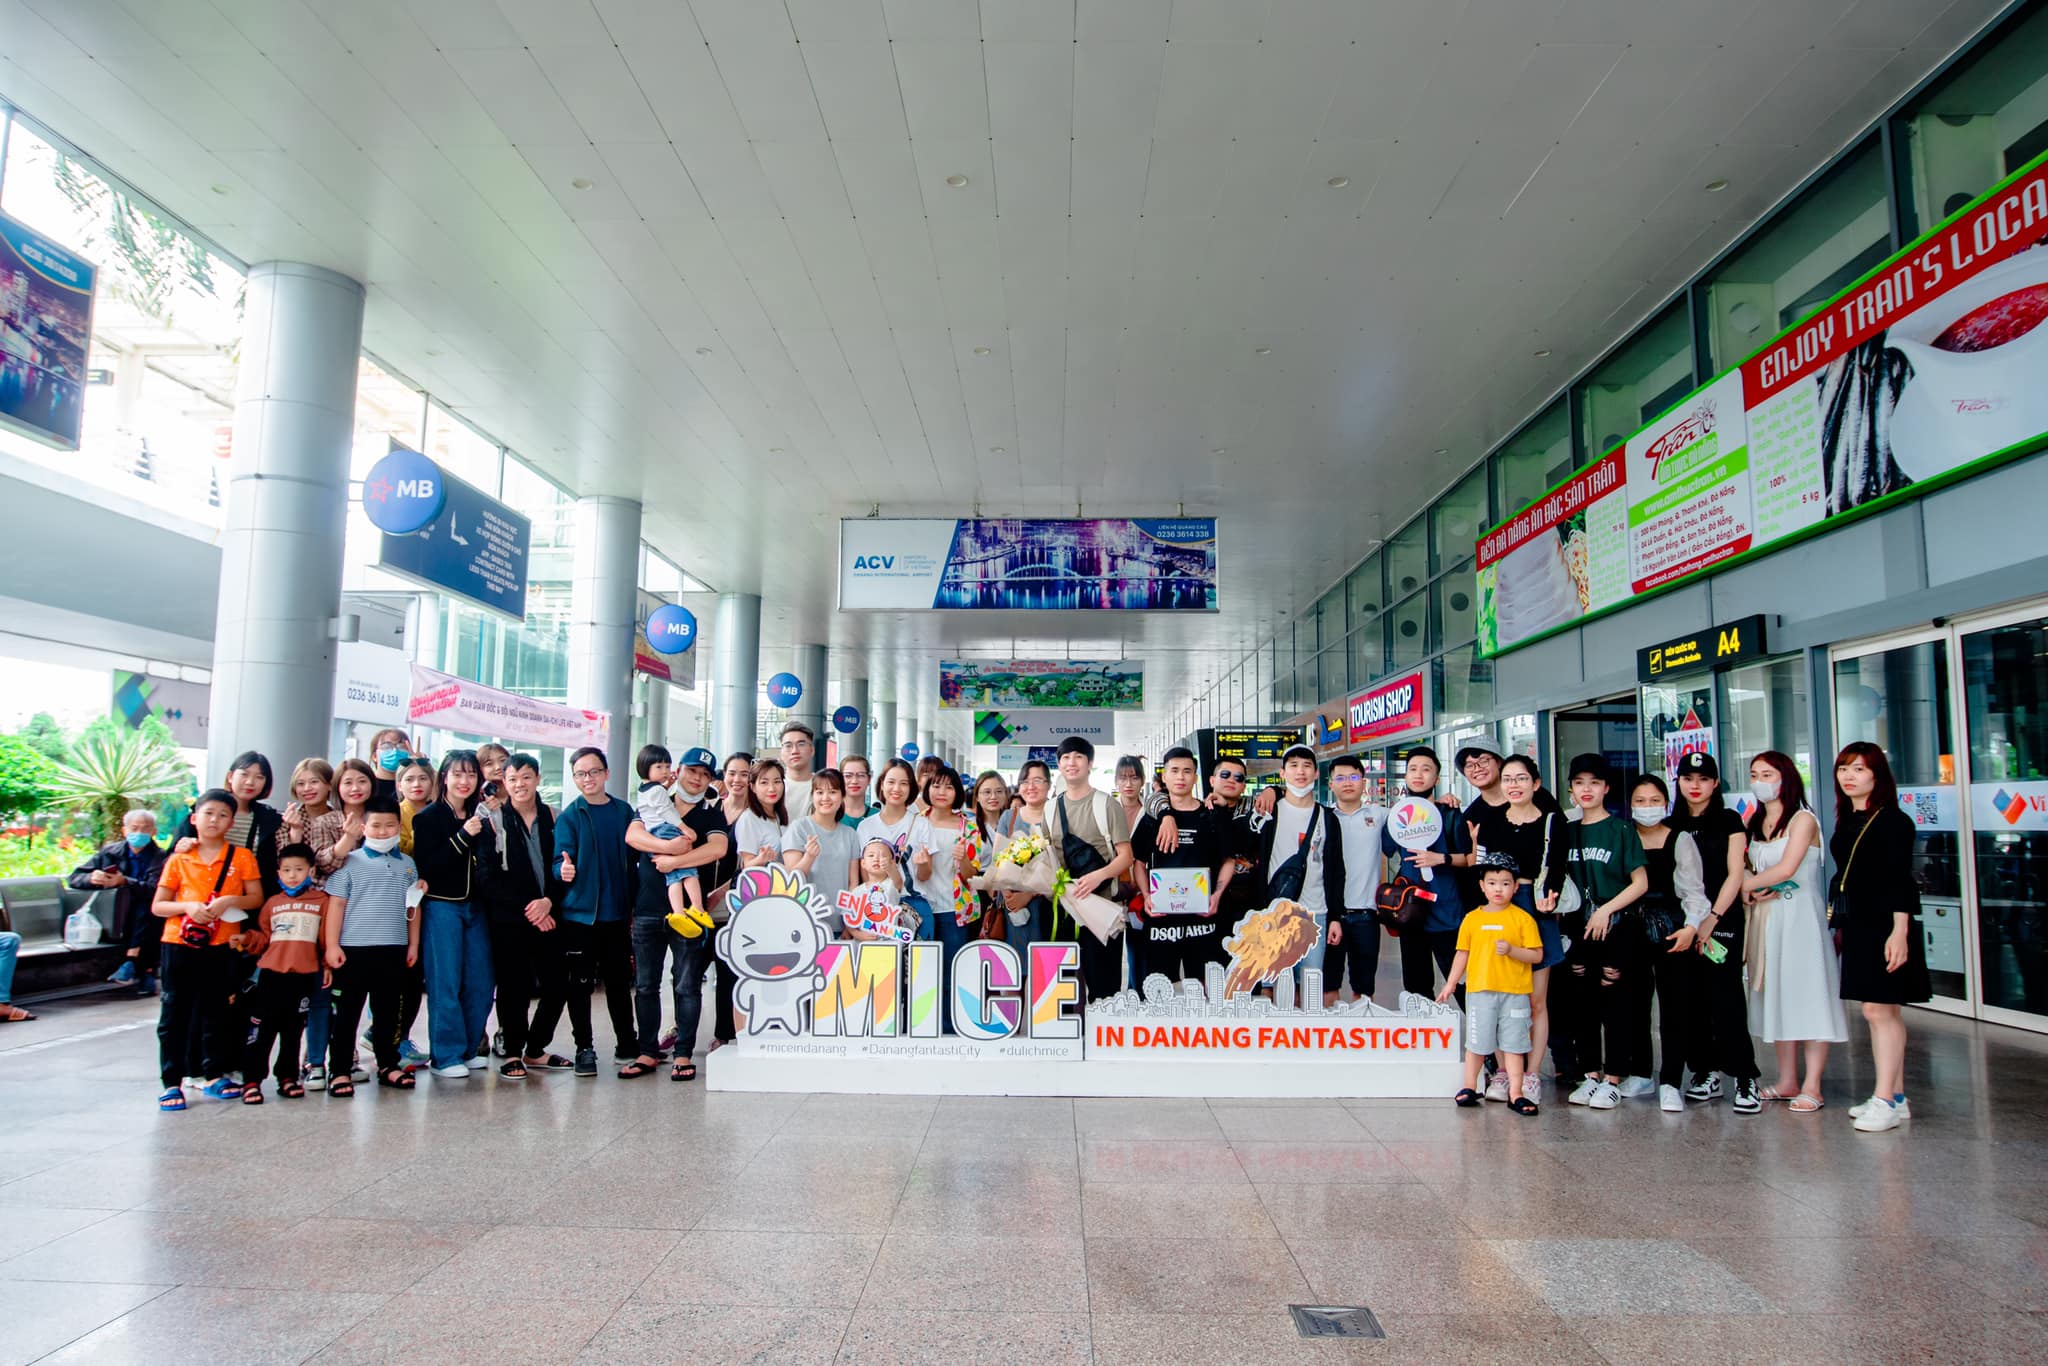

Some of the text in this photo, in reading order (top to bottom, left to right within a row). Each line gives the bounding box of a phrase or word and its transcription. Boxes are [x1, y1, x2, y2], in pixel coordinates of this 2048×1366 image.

[1759, 315, 1834, 389] ENJOY
[1839, 244, 1943, 338] TRAN'S
[396, 479, 434, 498] MB
[1480, 459, 1616, 564] ĐẾN ĐÀ NẴNG ĂN ĐẶC SẢN TRẦN
[1156, 530, 1209, 538] 0236 3614 338
[854, 555, 895, 569] ACV
[667, 623, 690, 635] MB
[1717, 627, 1741, 657] A4
[347, 687, 399, 707] 0236 3614 338
[782, 685, 798, 696] MB
[1350, 696, 1386, 729] TOURISM
[1386, 684, 1413, 718] SHOP
[844, 716, 857, 724] MB
[1690, 752, 1703, 767] C
[1397, 824, 1438, 840] DANANG
[838, 892, 900, 926] ENJOY
[863, 919, 911, 942] DANANG
[811, 940, 1082, 1041] MICE
[1096, 1025, 1125, 1048] IN
[1133, 1026, 1251, 1049] DANANG
[759, 1043, 847, 1057] #miceindanang
[999, 1044, 1069, 1056] #dulichmice
